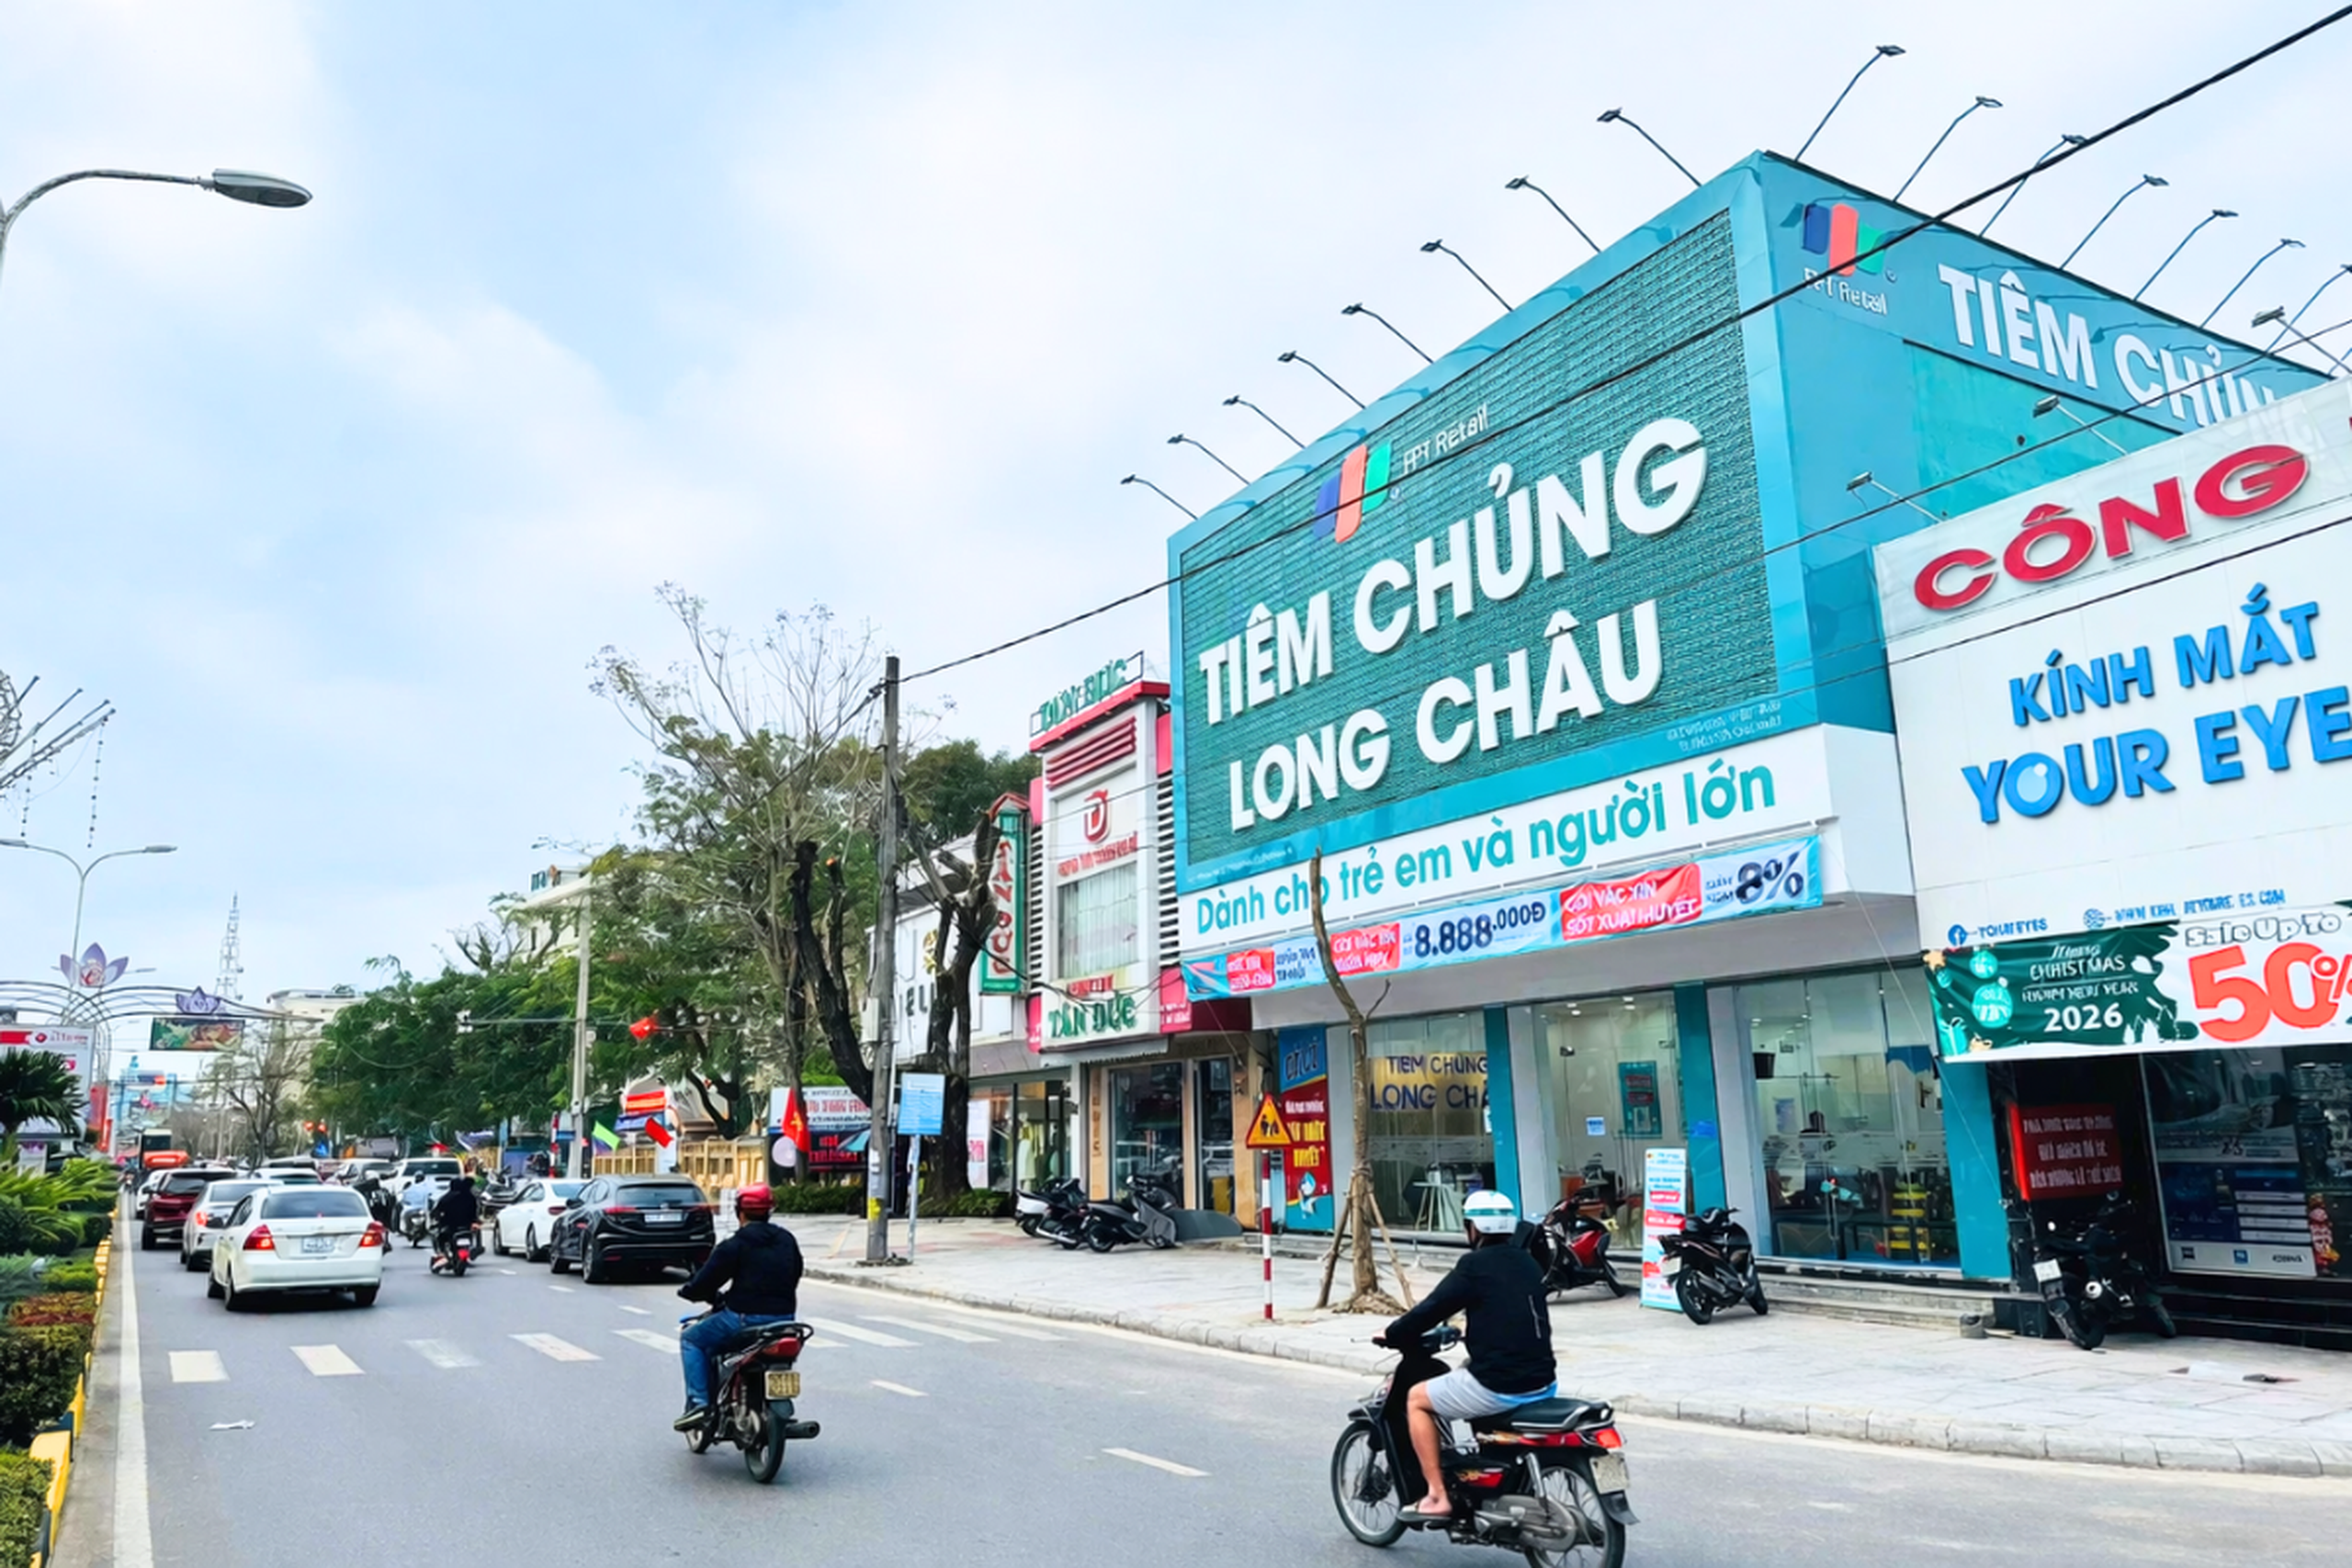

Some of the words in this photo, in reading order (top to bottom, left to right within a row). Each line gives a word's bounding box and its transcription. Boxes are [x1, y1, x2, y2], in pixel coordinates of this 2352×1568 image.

[1938, 264, 2099, 390] TIÊM
[1198, 591, 1334, 727] TIÊM
[1353, 417, 1709, 654] CHỦNG
[1914, 445, 2310, 610] CÔNG
[1229, 708, 1391, 832] LONG
[1416, 599, 1665, 765] CHÂU
[2009, 649, 2155, 727] KÍNH
[2173, 581, 2320, 688] MẮT
[1197, 884, 1265, 935] Dành
[1339, 848, 1385, 901] trẻ
[1395, 840, 1452, 889] em
[1461, 816, 1515, 869] và
[1529, 770, 1667, 866] người
[1683, 757, 1777, 827] lớn
[1962, 728, 2177, 826] YOUR
[2043, 1001, 2124, 1033] 2026
[1370, 1083, 1437, 1111] LONG
